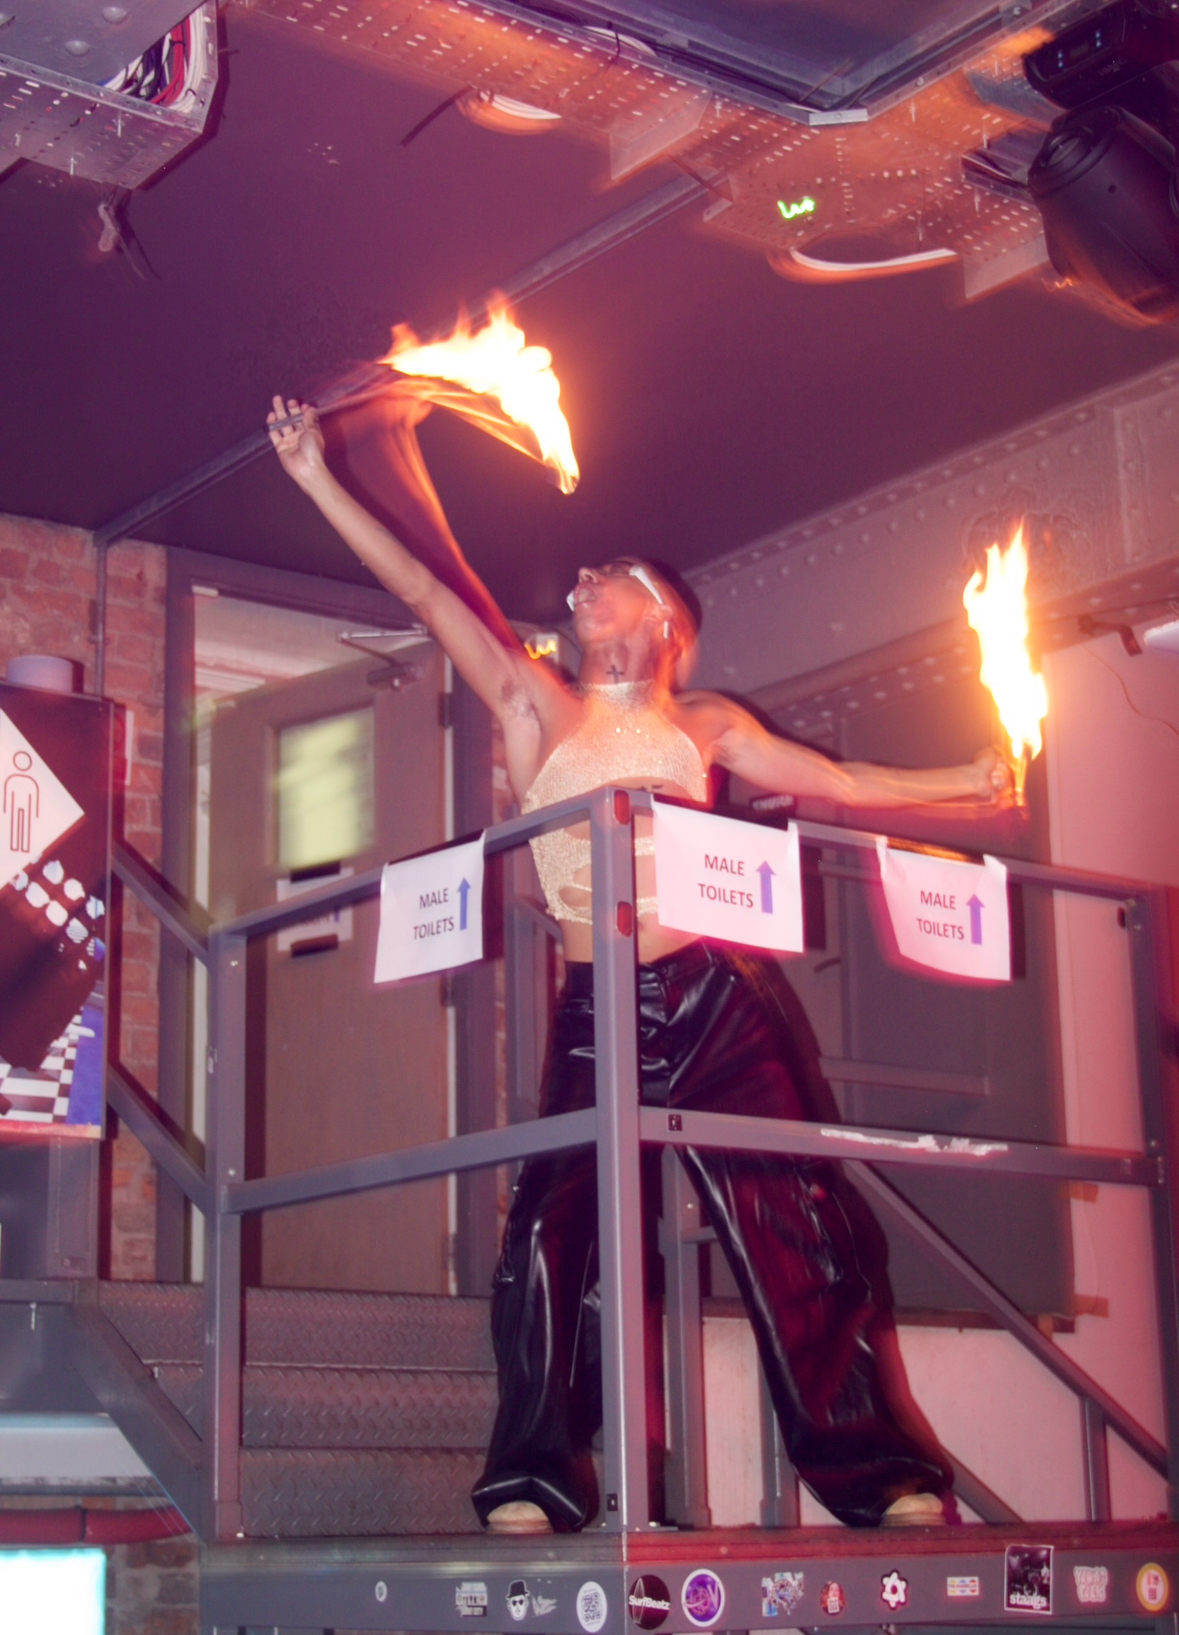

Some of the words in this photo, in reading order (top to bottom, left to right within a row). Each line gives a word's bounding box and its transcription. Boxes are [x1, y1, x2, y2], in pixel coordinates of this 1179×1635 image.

[703, 854, 745, 876] MALE
[419, 888, 449, 909] MALE
[697, 882, 754, 908] TOILETS
[920, 890, 956, 910] MALE
[413, 916, 454, 940] TOILETS
[916, 917, 964, 941] TOILETS
[628, 1595, 671, 1610] SurfBeatz
[1010, 1592, 1047, 1610] staags
